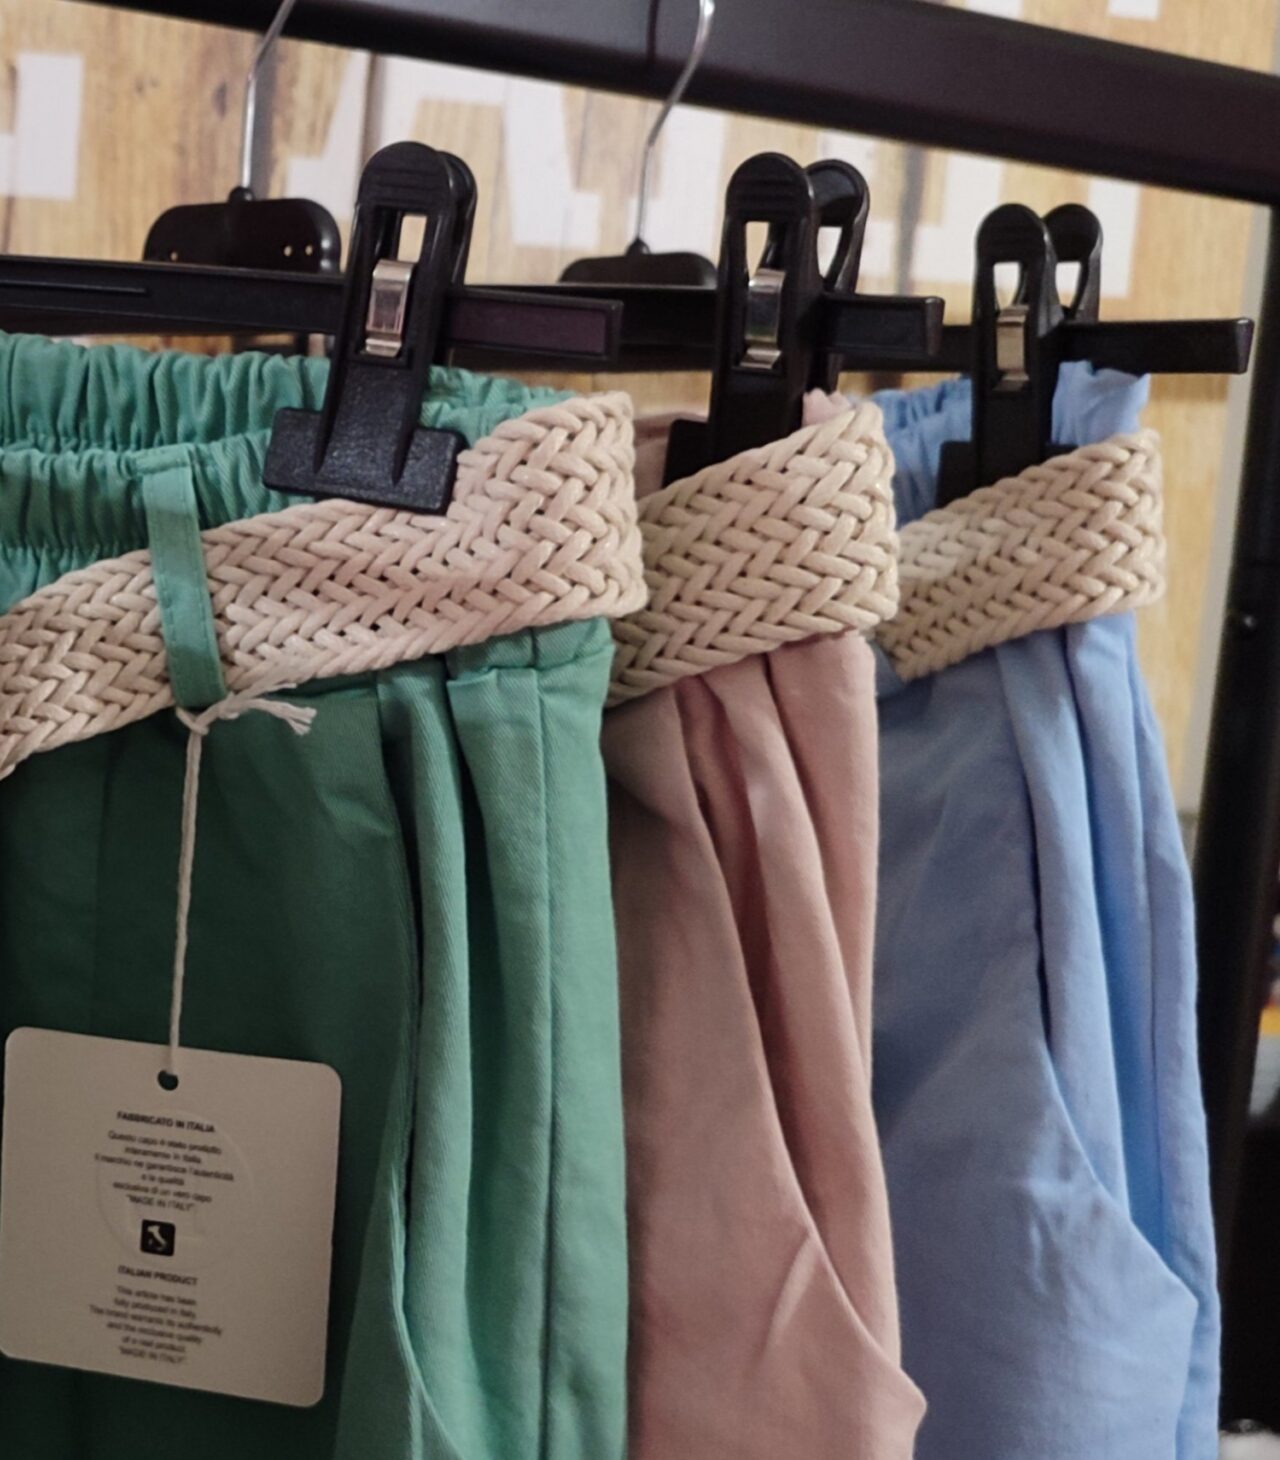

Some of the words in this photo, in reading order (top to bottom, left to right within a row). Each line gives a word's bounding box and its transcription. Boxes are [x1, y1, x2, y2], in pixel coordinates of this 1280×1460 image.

[116, 1111, 173, 1126] FABBRICATO
[176, 1119, 185, 1129] IN
[186, 1121, 216, 1132] ITALIA
[118, 1265, 152, 1278] ITALIAN
[154, 1271, 198, 1285] PRODUCT
